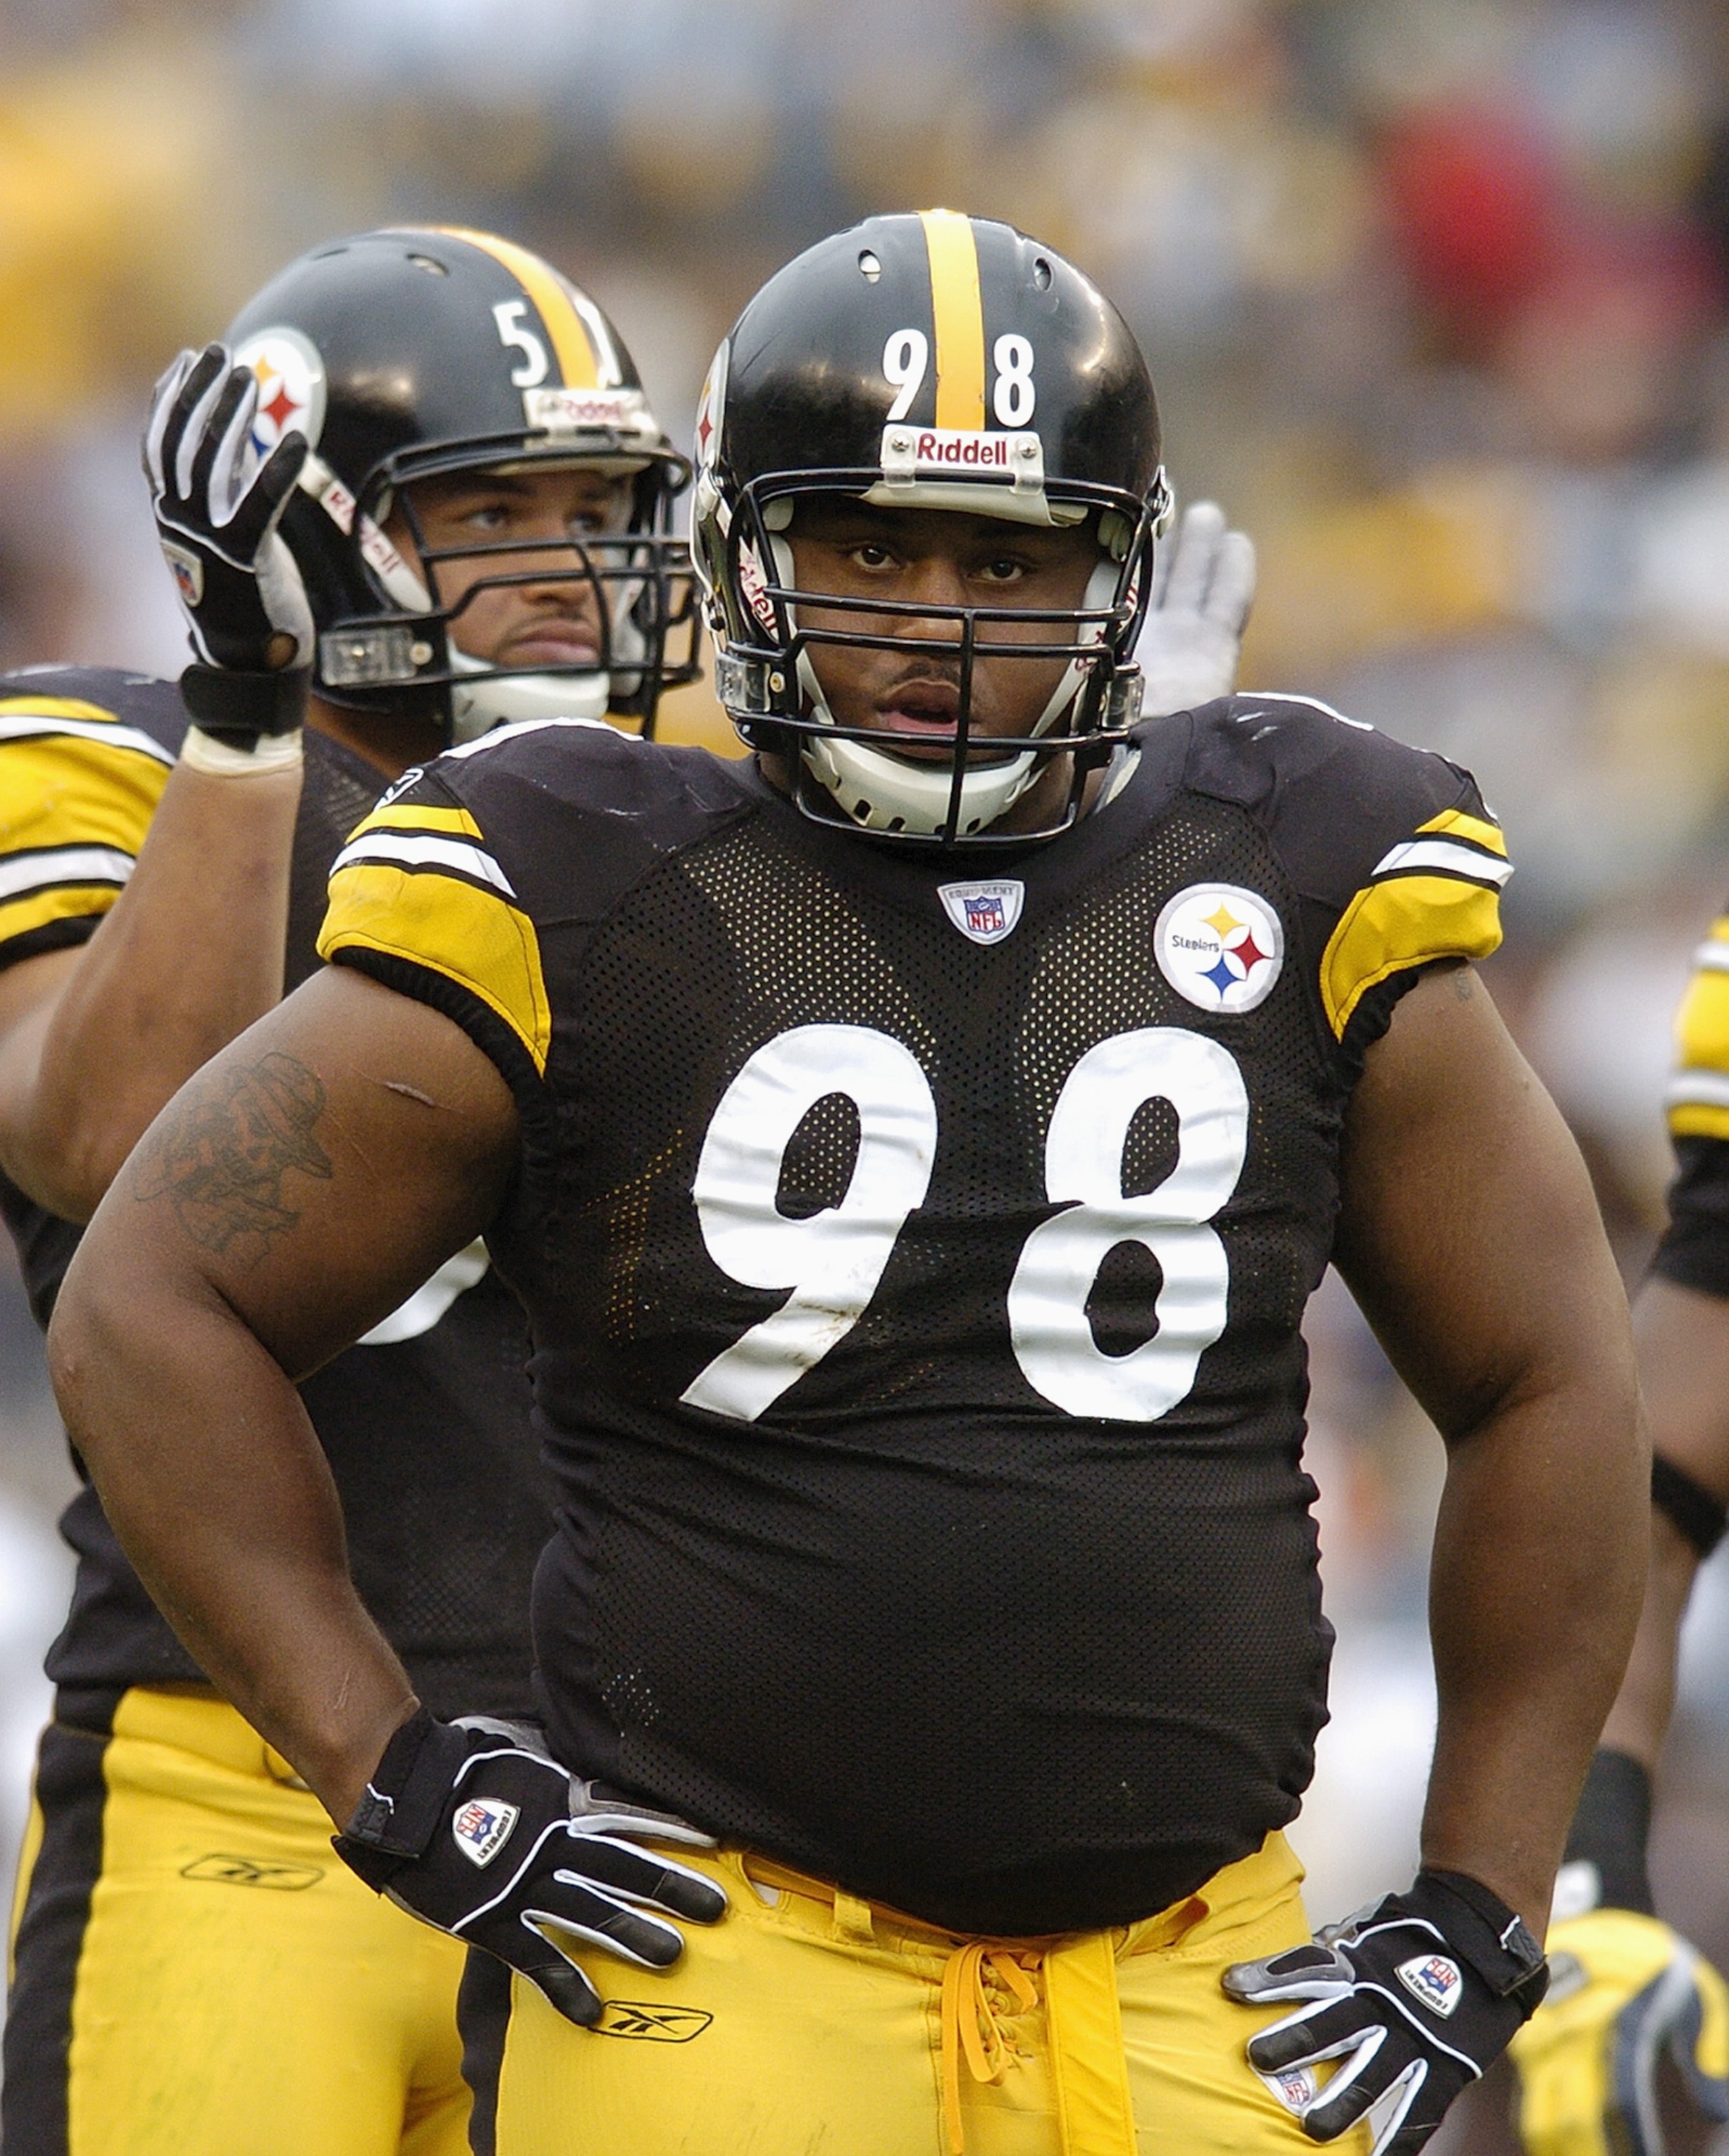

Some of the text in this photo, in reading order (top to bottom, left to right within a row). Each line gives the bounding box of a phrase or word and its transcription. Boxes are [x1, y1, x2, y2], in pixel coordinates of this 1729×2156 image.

[917, 433, 1007, 465] Riddell
[969, 911, 1002, 931] NFL
[1172, 934, 1220, 952] Steelers
[679, 1023, 1250, 1422] 98
[457, 1804, 486, 1833] NFL
[1430, 1958, 1459, 1991] NFL
